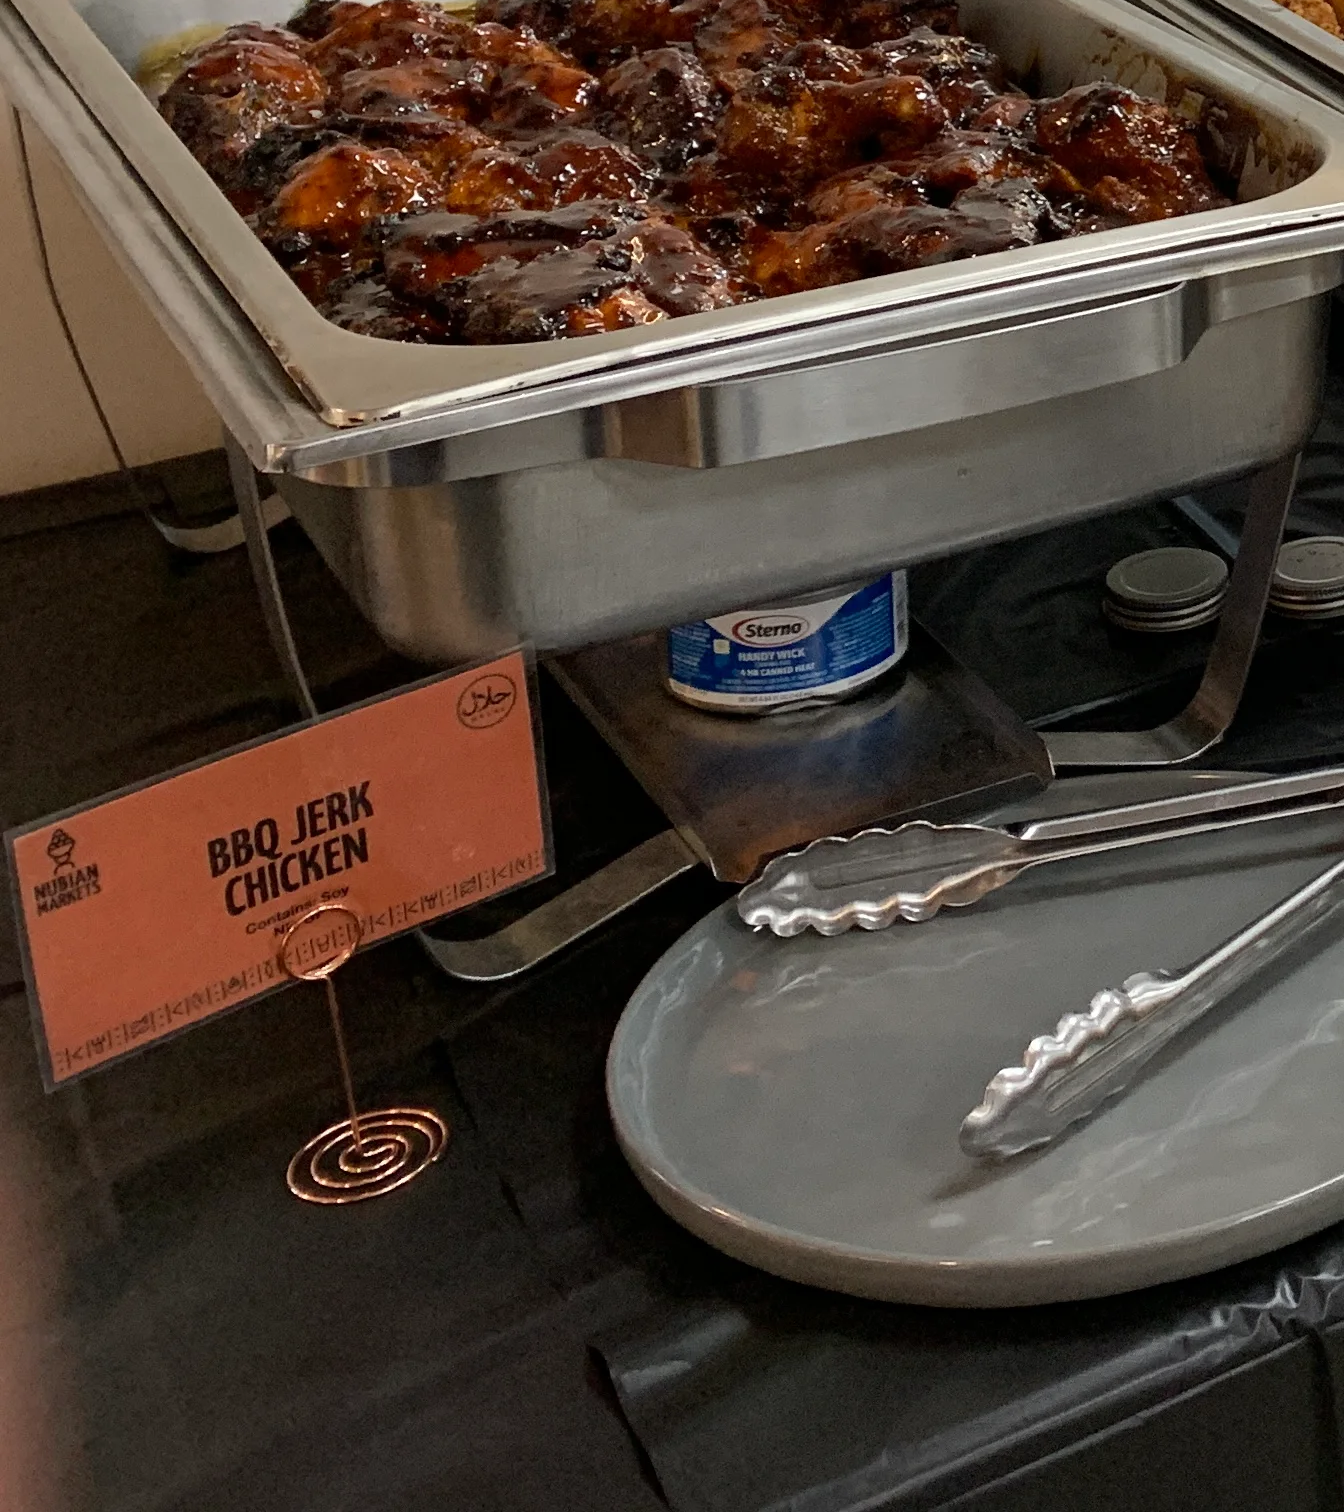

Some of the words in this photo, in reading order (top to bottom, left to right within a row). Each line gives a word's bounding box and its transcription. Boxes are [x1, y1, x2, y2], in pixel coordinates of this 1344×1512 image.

[745, 622, 802, 638] Sterno
[776, 647, 805, 660] WICK
[208, 818, 283, 878] BBQ
[290, 780, 374, 846] JERK
[34, 863, 99, 901] NUBIAN
[225, 828, 369, 916] CHICKEN
[37, 885, 101, 917] MARKETS
[321, 886, 350, 902] Soy
